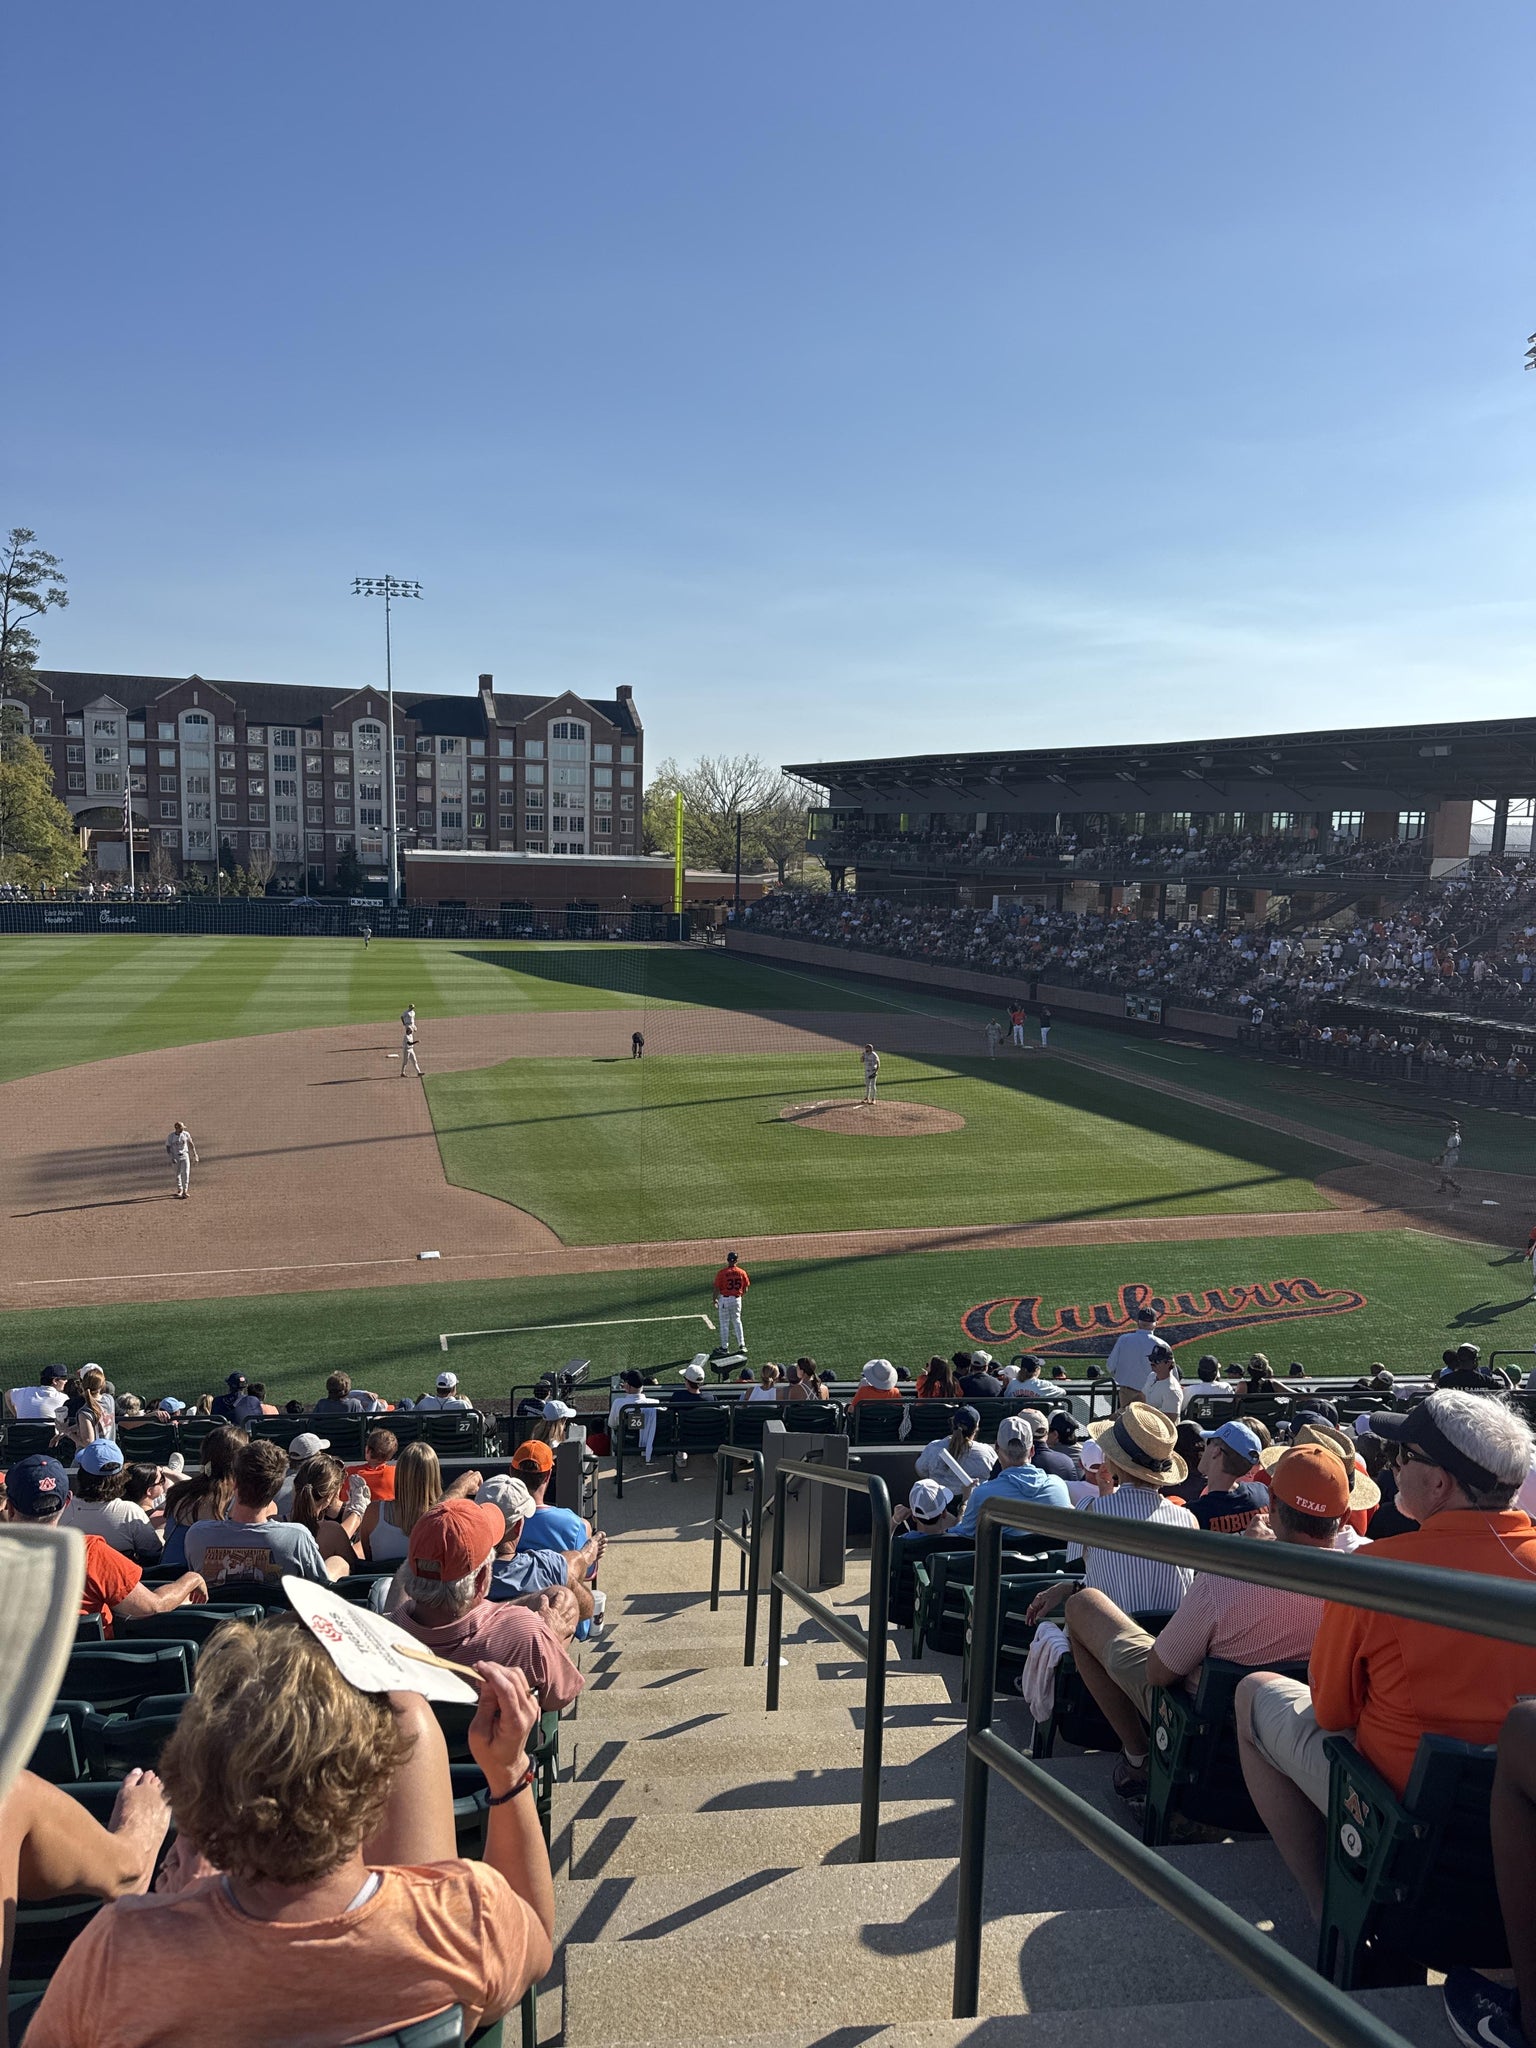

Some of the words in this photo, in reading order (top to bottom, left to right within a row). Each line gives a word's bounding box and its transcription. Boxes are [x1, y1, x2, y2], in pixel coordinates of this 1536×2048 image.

[1398, 1025, 1419, 1036] YETI
[1452, 1033, 1474, 1045] YETI
[1511, 1043, 1534, 1055] YETI
[727, 1279, 742, 1291] 35
[961, 1278, 1366, 1346] Auburn
[1200, 1408, 1212, 1416] 25
[459, 1423, 471, 1432] 27
[630, 1418, 642, 1427] 26
[1295, 1495, 1327, 1513] TEXAS
[328, 1611, 369, 1655] TIGERS
[1347, 1832, 1356, 1851] Q
